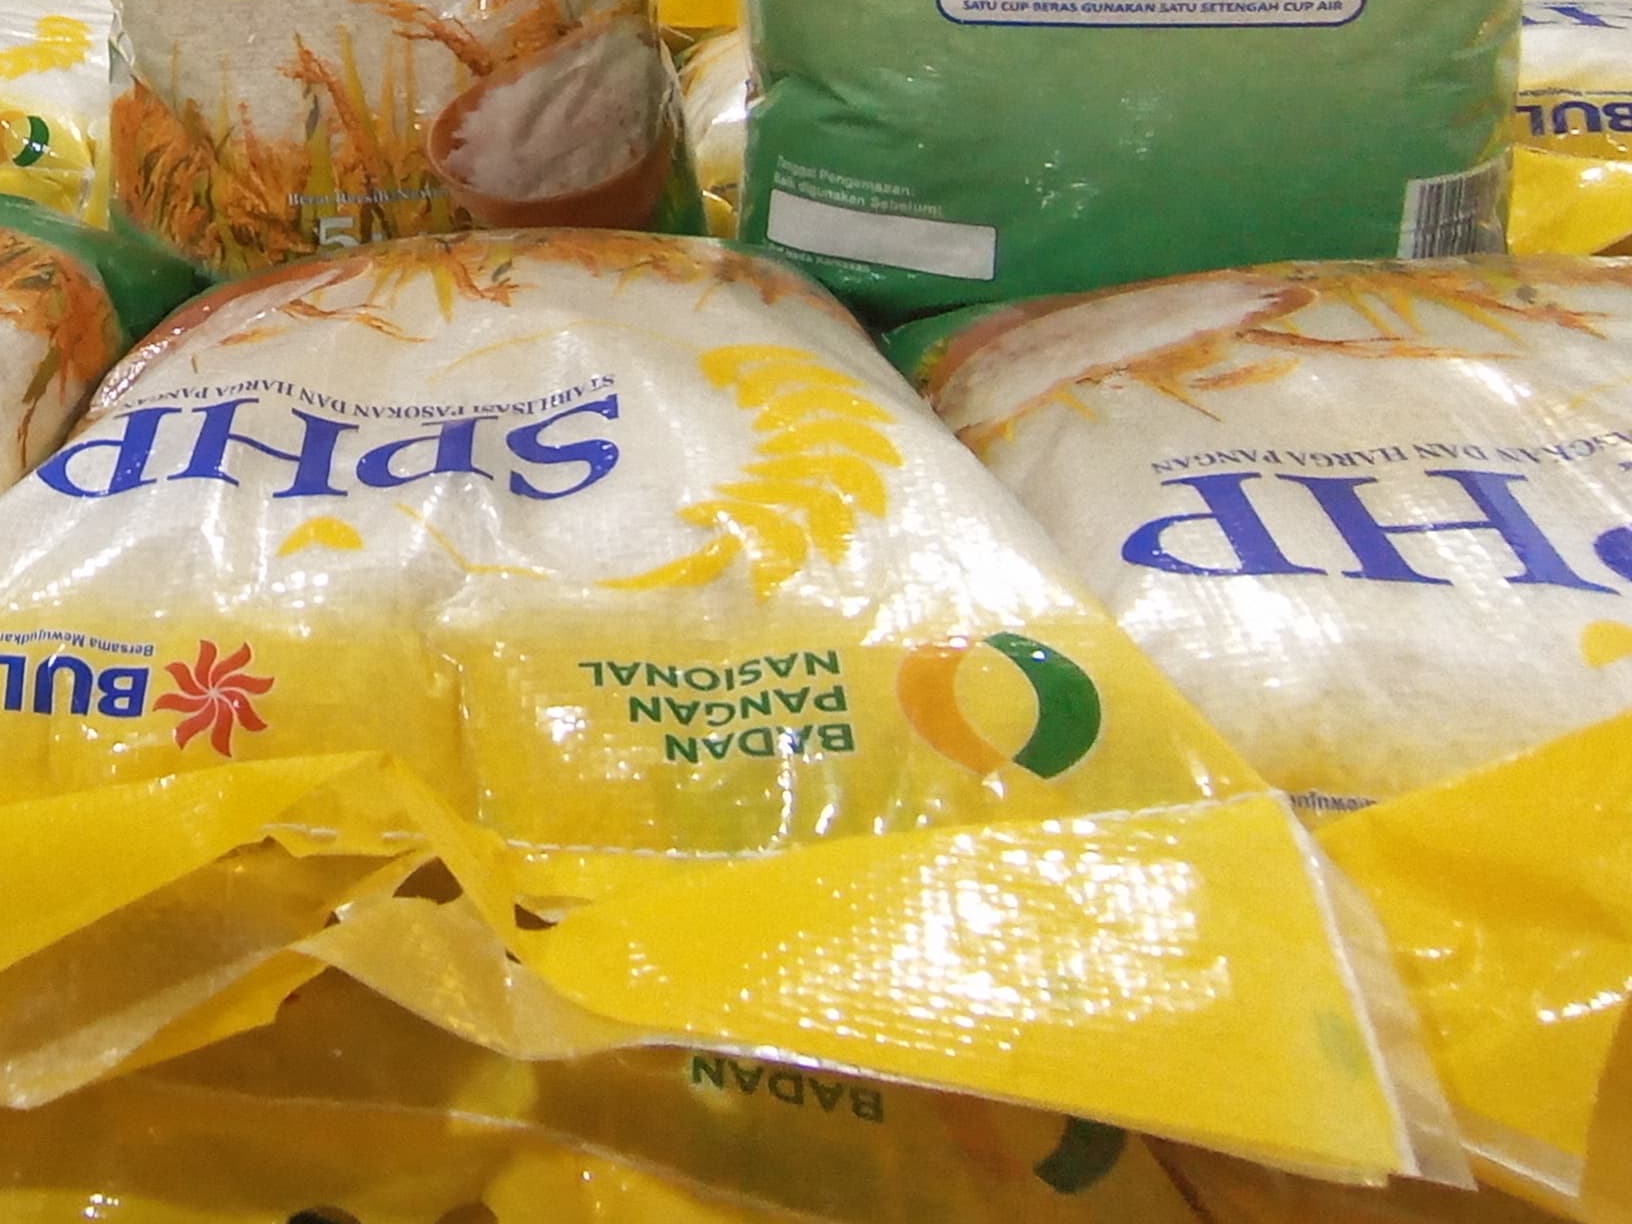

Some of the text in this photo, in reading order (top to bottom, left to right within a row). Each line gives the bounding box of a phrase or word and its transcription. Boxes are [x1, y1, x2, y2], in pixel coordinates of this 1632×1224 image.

[963, 0, 1343, 14] SATU CUP BERAS GUNAKAN SATU SETENGAH CUP AIR
[215, 379, 293, 397] HARGA
[299, 387, 346, 415] DAN
[472, 376, 615, 418] STABILISASI
[353, 403, 464, 418] PASOKAN
[35, 393, 620, 500] SPHP
[1286, 445, 1408, 470] HARGA
[1413, 443, 1489, 462] DAN
[1151, 449, 1281, 474] PANGAN
[90, 637, 154, 657] Bersama
[578, 650, 840, 692] NASIONAL
[628, 684, 849, 727] PANGAN
[664, 723, 855, 764] BADAN
[692, 1055, 884, 1123] BADAN
